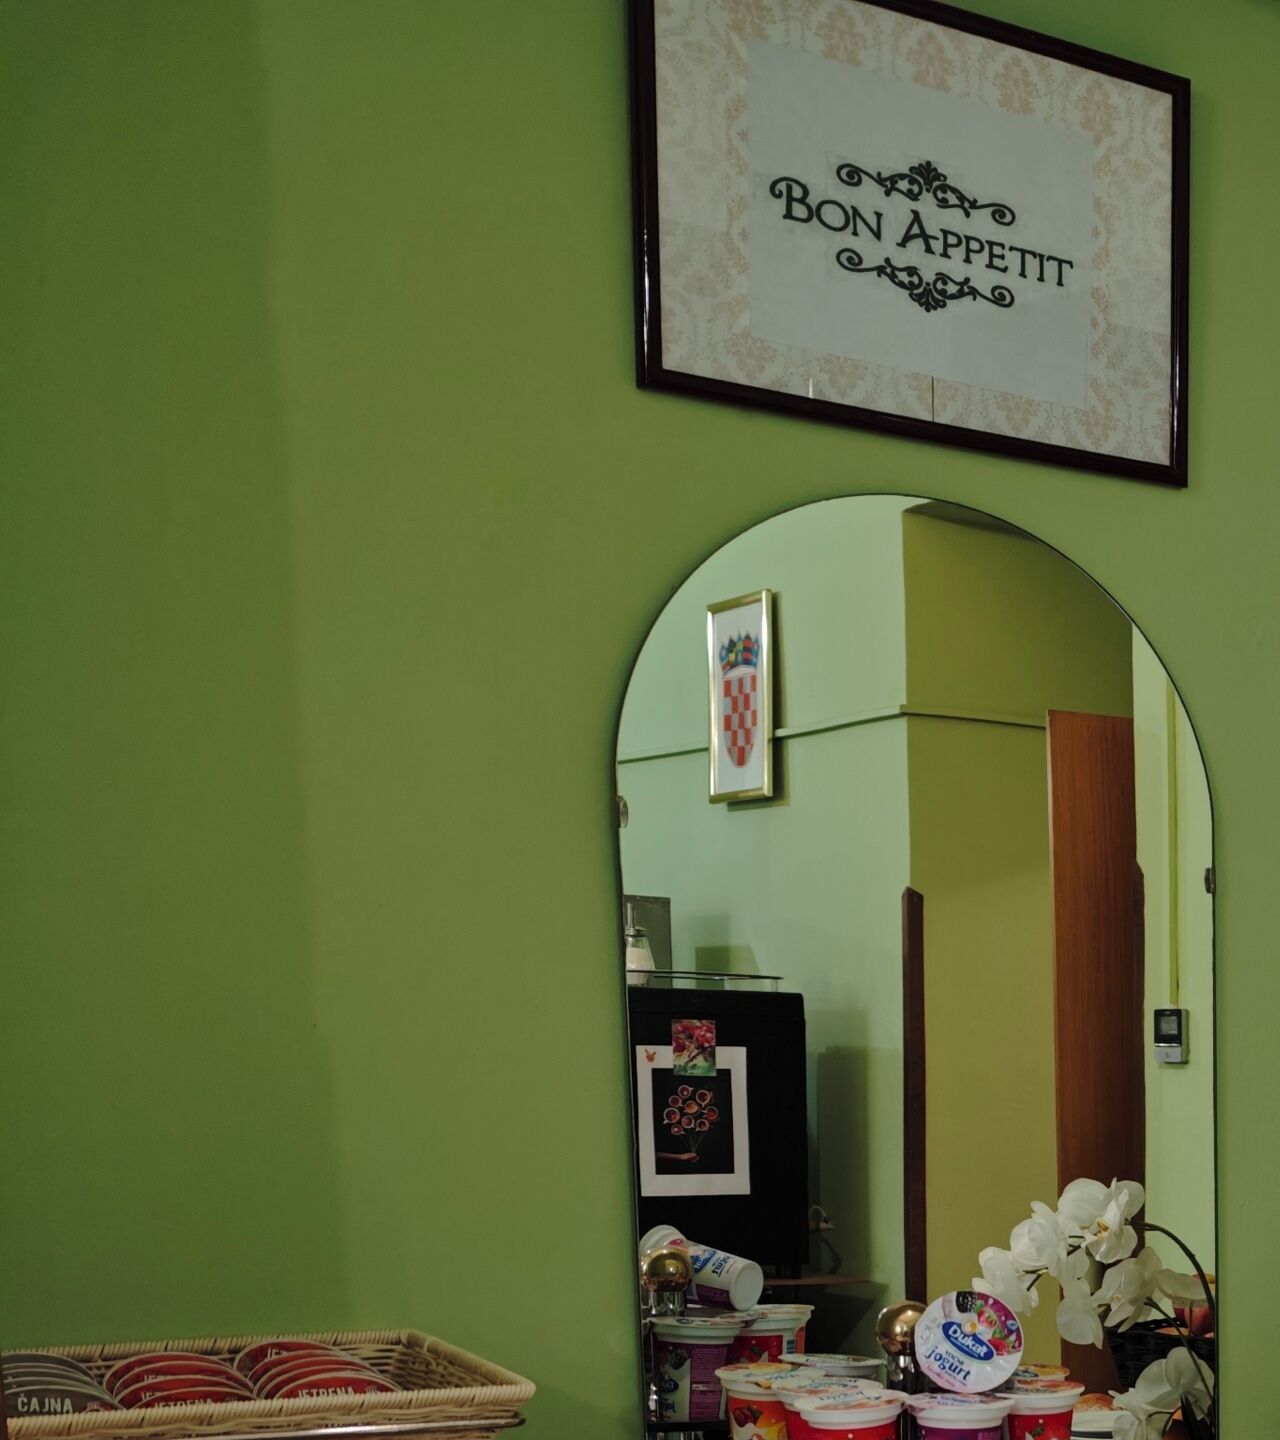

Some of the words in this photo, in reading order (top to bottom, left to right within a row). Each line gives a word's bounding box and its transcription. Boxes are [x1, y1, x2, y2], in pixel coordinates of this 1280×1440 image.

[769, 176, 883, 242] BON
[896, 208, 1074, 287] APPETIT
[948, 1325, 988, 1358] Dukat
[925, 1345, 973, 1382] jogurt
[17, 1393, 73, 1414] ČAJNA
